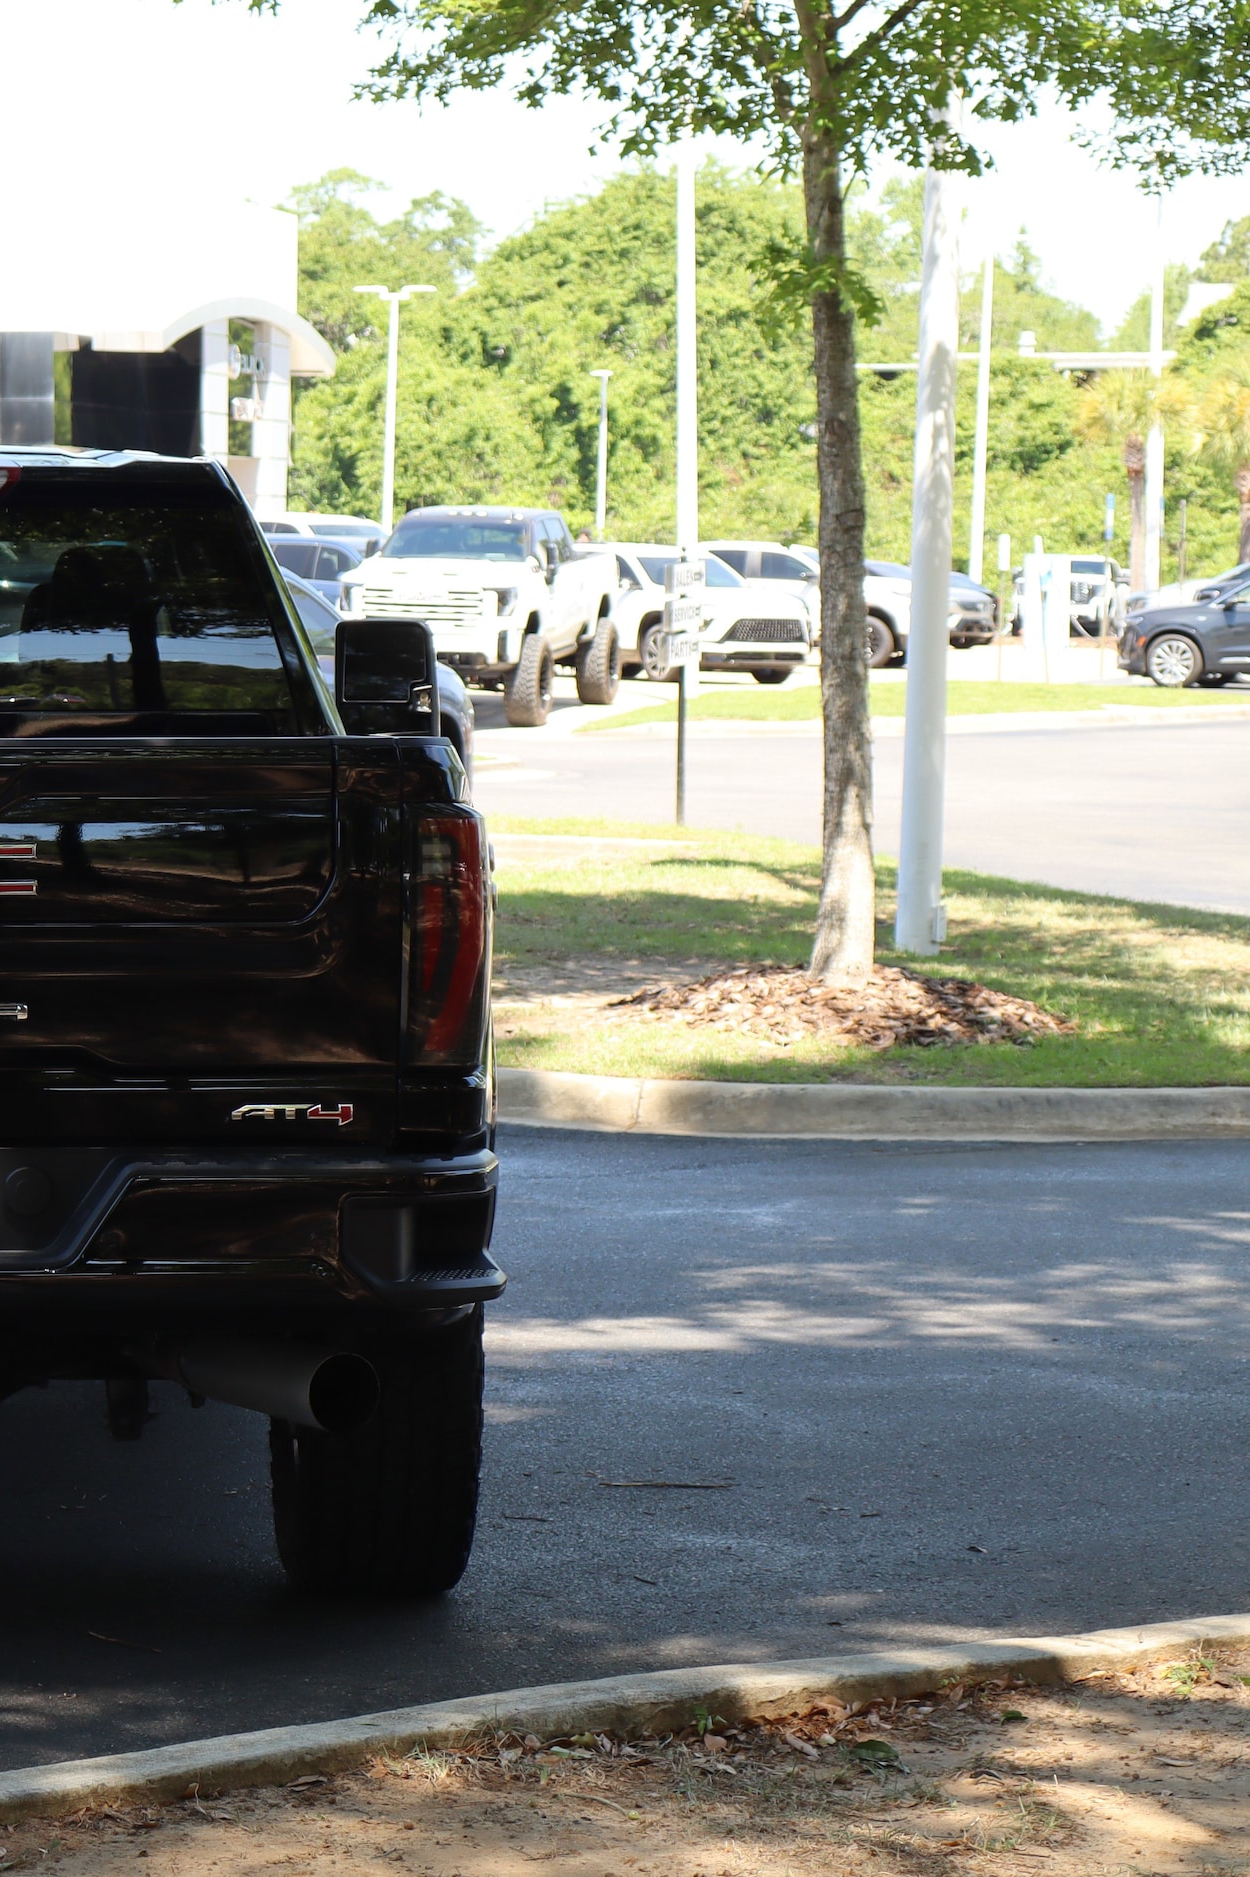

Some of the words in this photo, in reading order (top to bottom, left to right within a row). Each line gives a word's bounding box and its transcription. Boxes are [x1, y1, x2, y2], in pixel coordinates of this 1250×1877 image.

[675, 569, 693, 588] SALES
[674, 605, 696, 622] SERVICE
[231, 1104, 354, 1126] AT4
